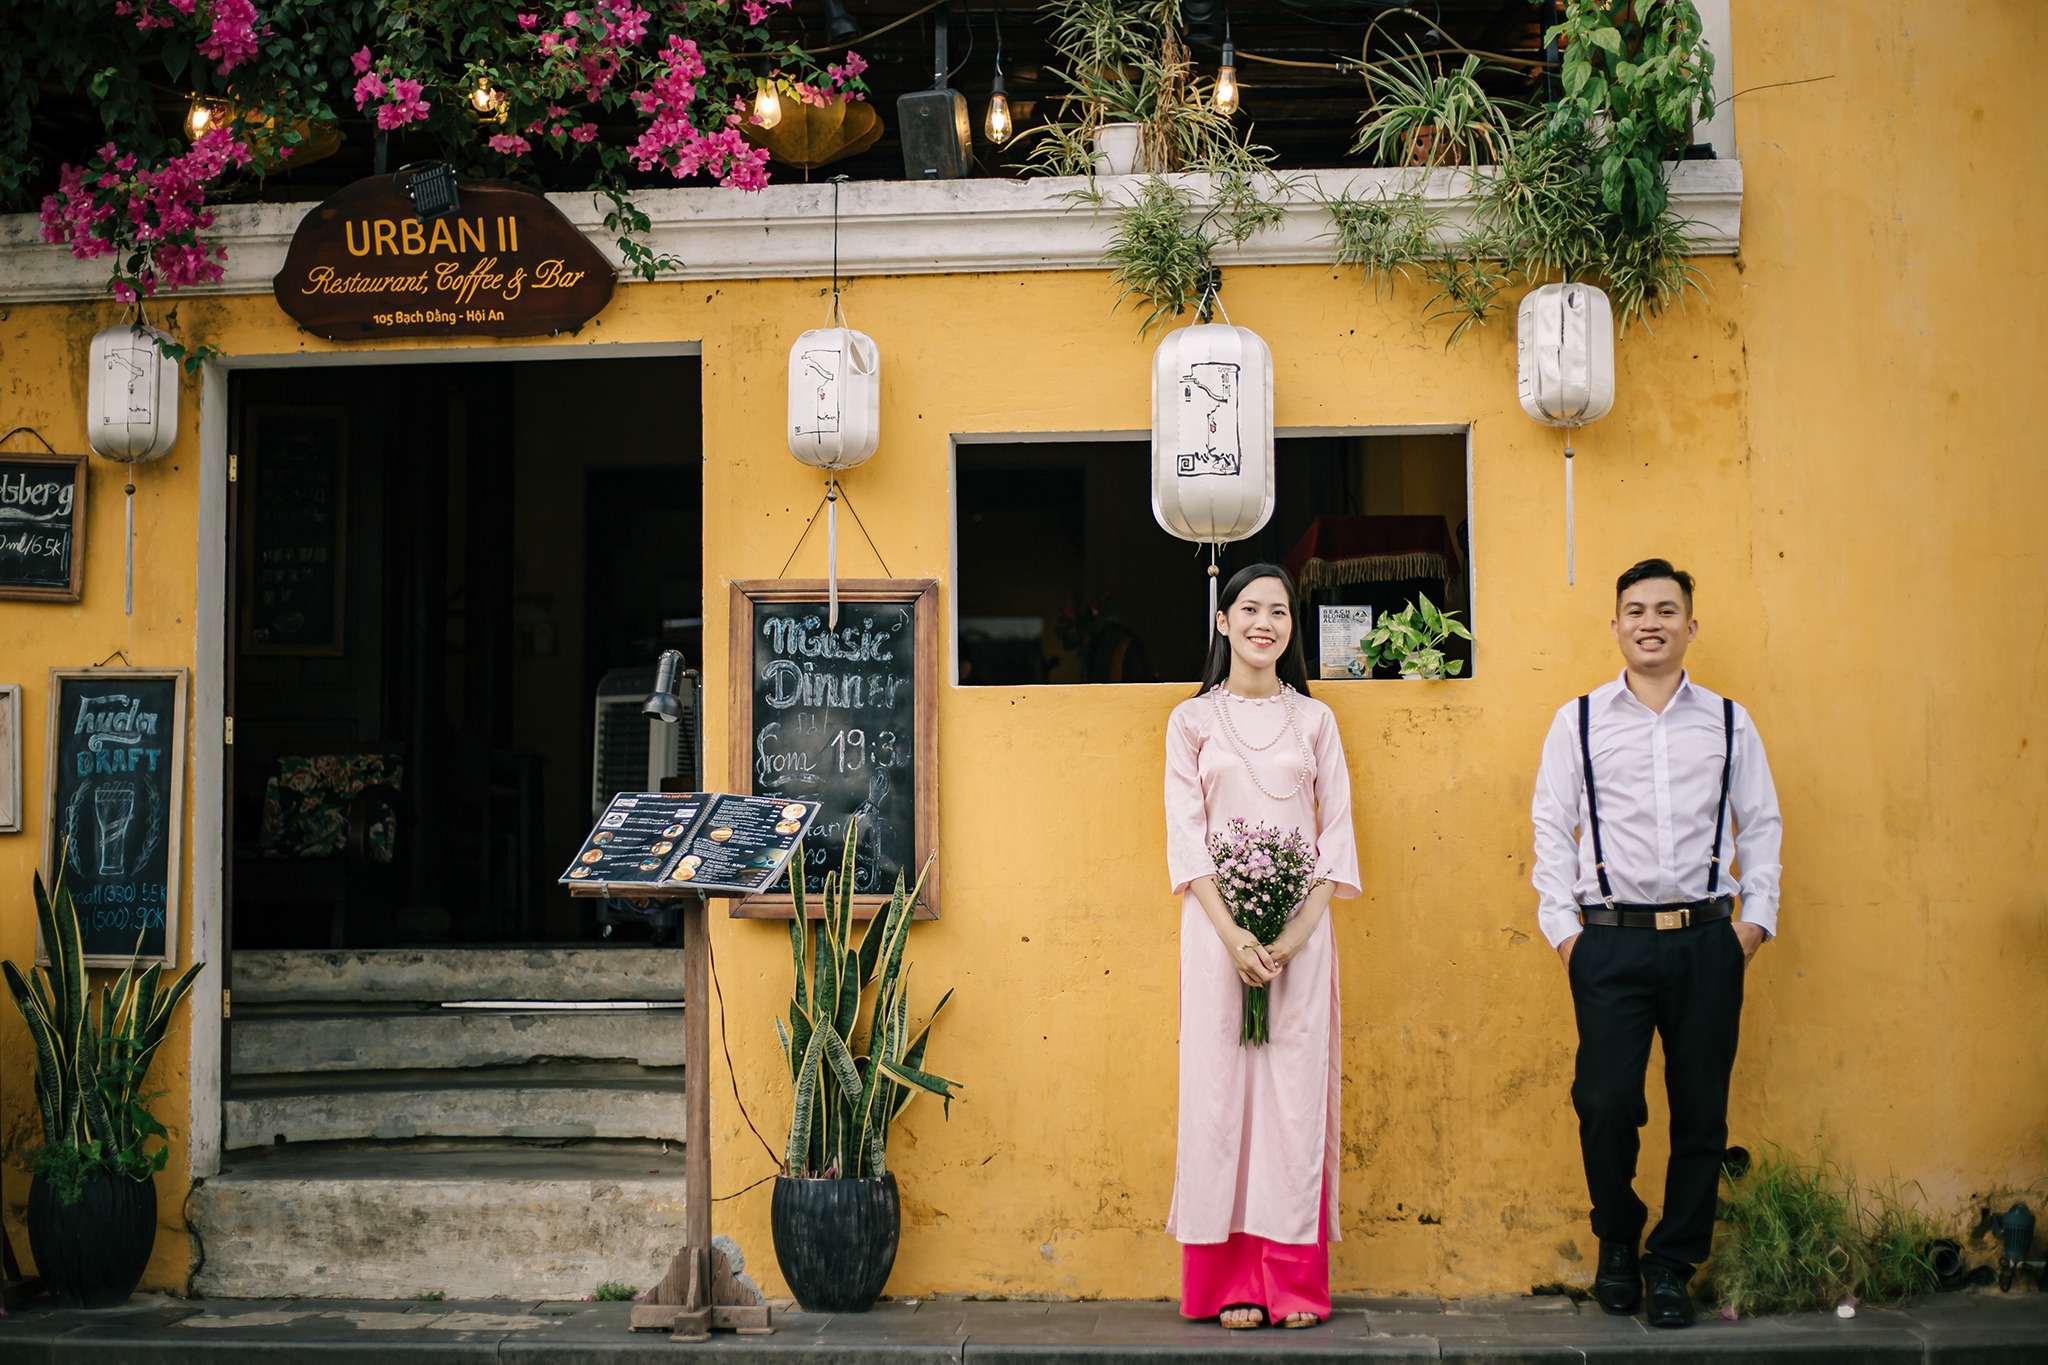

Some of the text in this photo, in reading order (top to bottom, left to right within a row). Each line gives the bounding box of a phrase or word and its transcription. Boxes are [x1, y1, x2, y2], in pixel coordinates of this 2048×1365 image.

[345, 215, 518, 257] URBAN II
[301, 257, 586, 305] Restaurant, Coffee & Bar
[373, 313, 394, 326] 105
[395, 310, 424, 326] Bạch
[426, 308, 457, 325] Đằng
[466, 309, 486, 323] Hội
[488, 309, 505, 321] An
[0, 472, 75, 516] lsberg
[761, 659, 910, 710] Dinner
[76, 748, 162, 776] DRAFT
[756, 722, 817, 780] from
